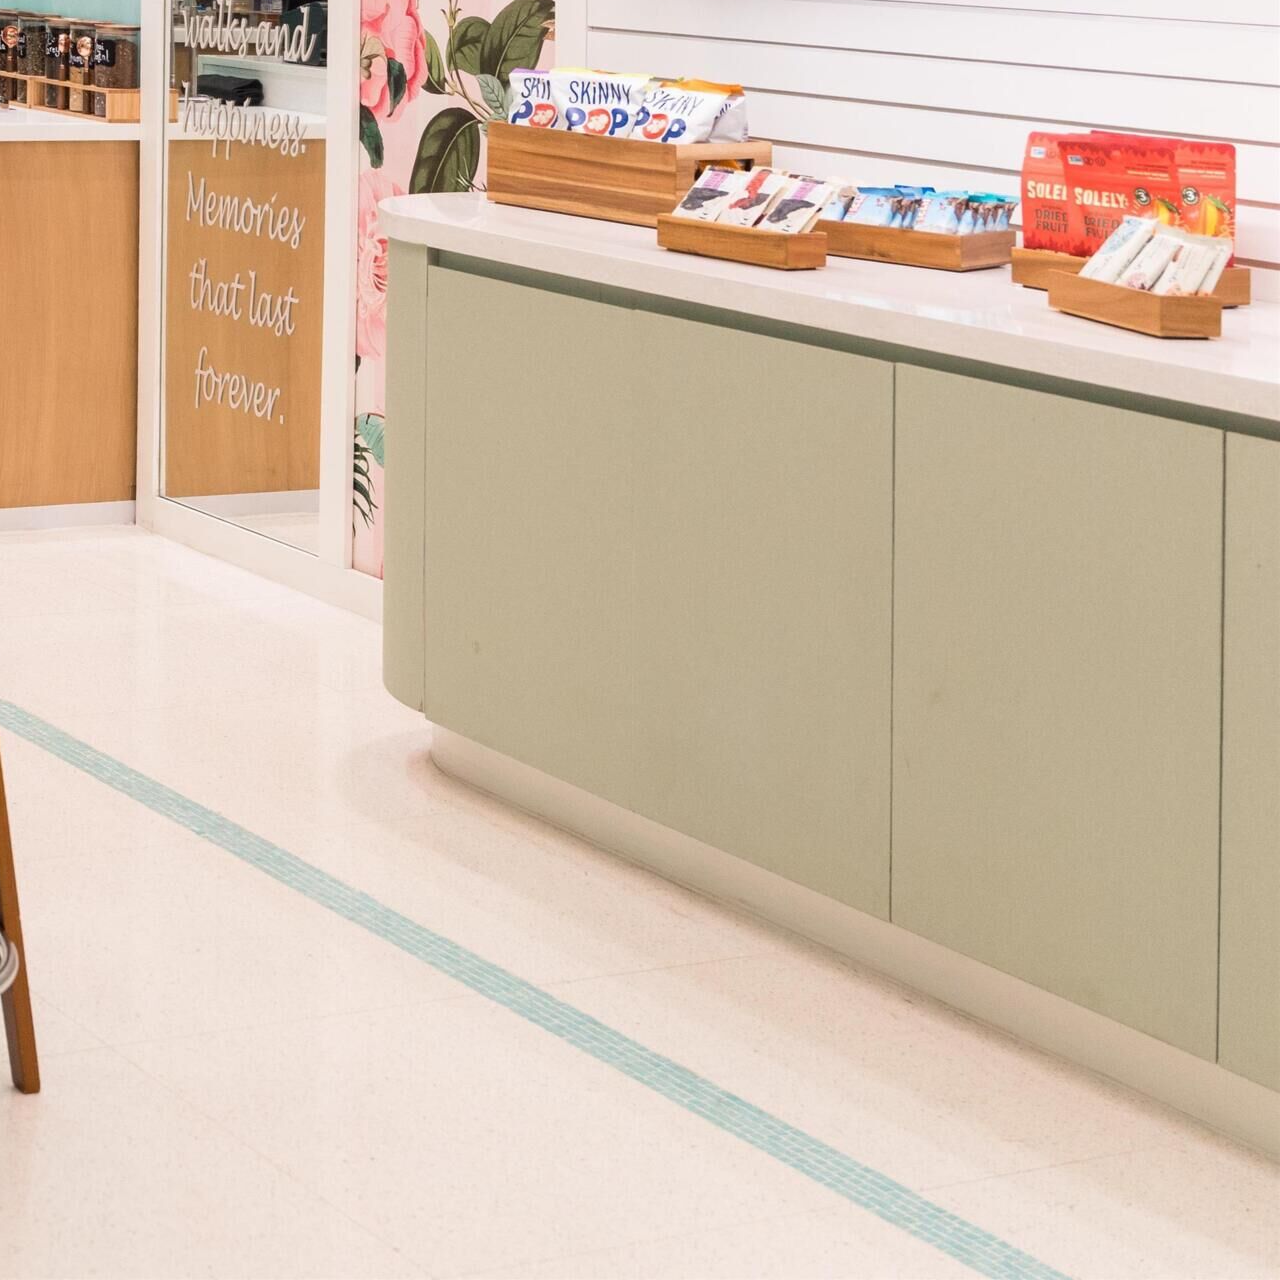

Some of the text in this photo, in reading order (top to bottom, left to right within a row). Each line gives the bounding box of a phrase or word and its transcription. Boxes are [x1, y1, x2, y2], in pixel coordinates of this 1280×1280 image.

[255, 6, 317, 63] and
[181, 80, 307, 160] happiness.
[565, 107, 629, 136] POP
[635, 106, 687, 143] POP
[186, 171, 306, 249] Memories
[1074, 187, 1126, 209] SOLELY
[189, 258, 299, 336] that last
[195, 346, 284, 424] forever.
